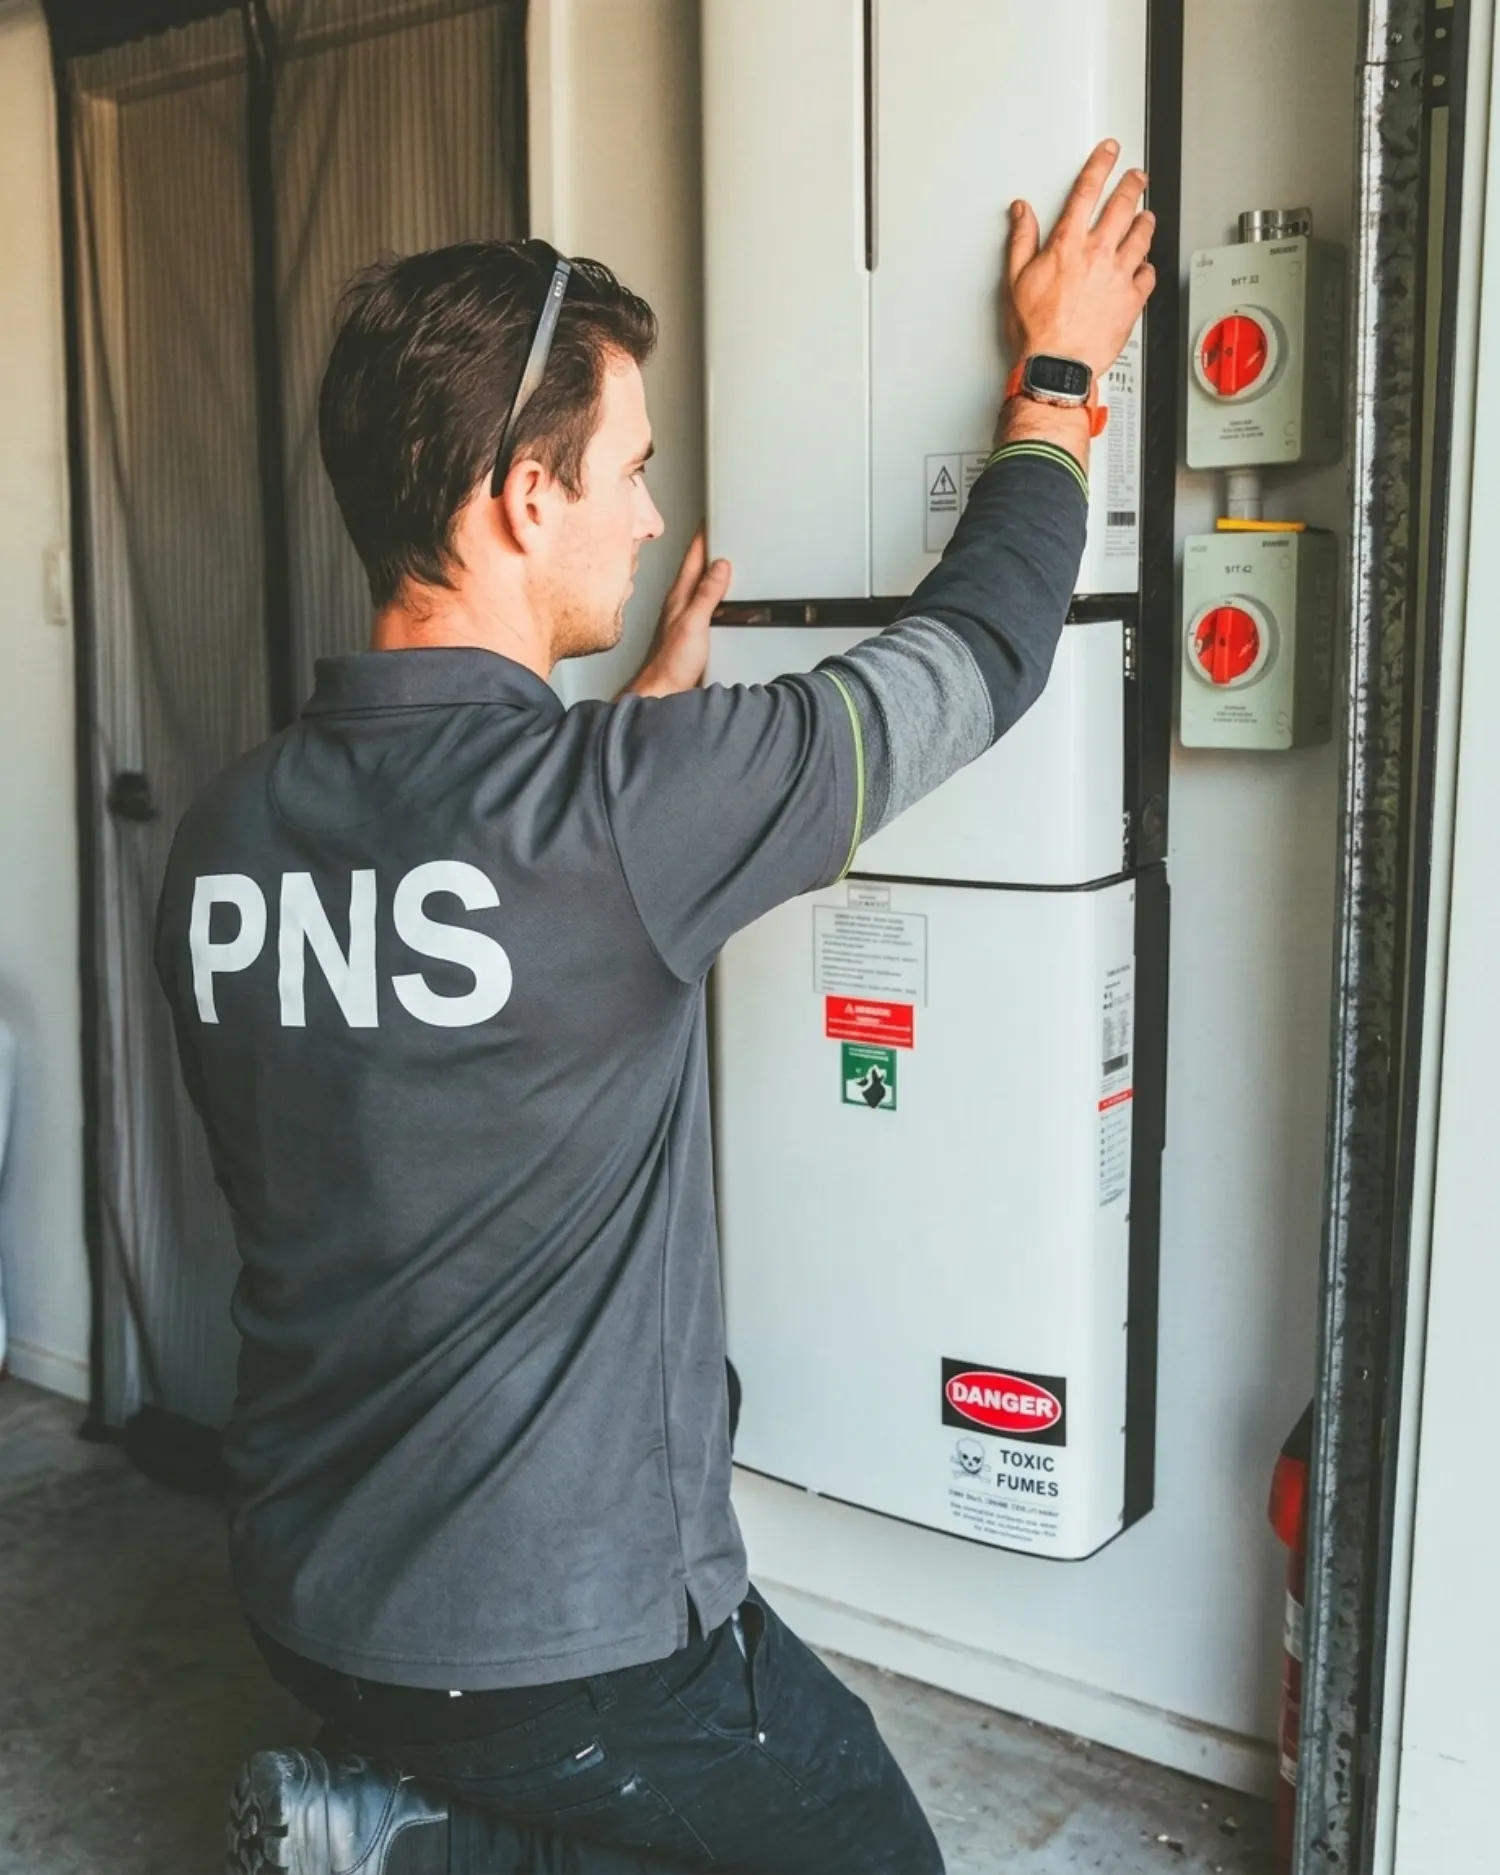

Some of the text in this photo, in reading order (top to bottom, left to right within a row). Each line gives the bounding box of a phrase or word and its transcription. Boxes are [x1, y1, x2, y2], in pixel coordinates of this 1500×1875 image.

[189, 860, 513, 1028] PNS
[951, 1381, 1054, 1419] DANGER
[1000, 1449, 1055, 1473] TOXIC
[996, 1473, 1059, 1498] FUMES
